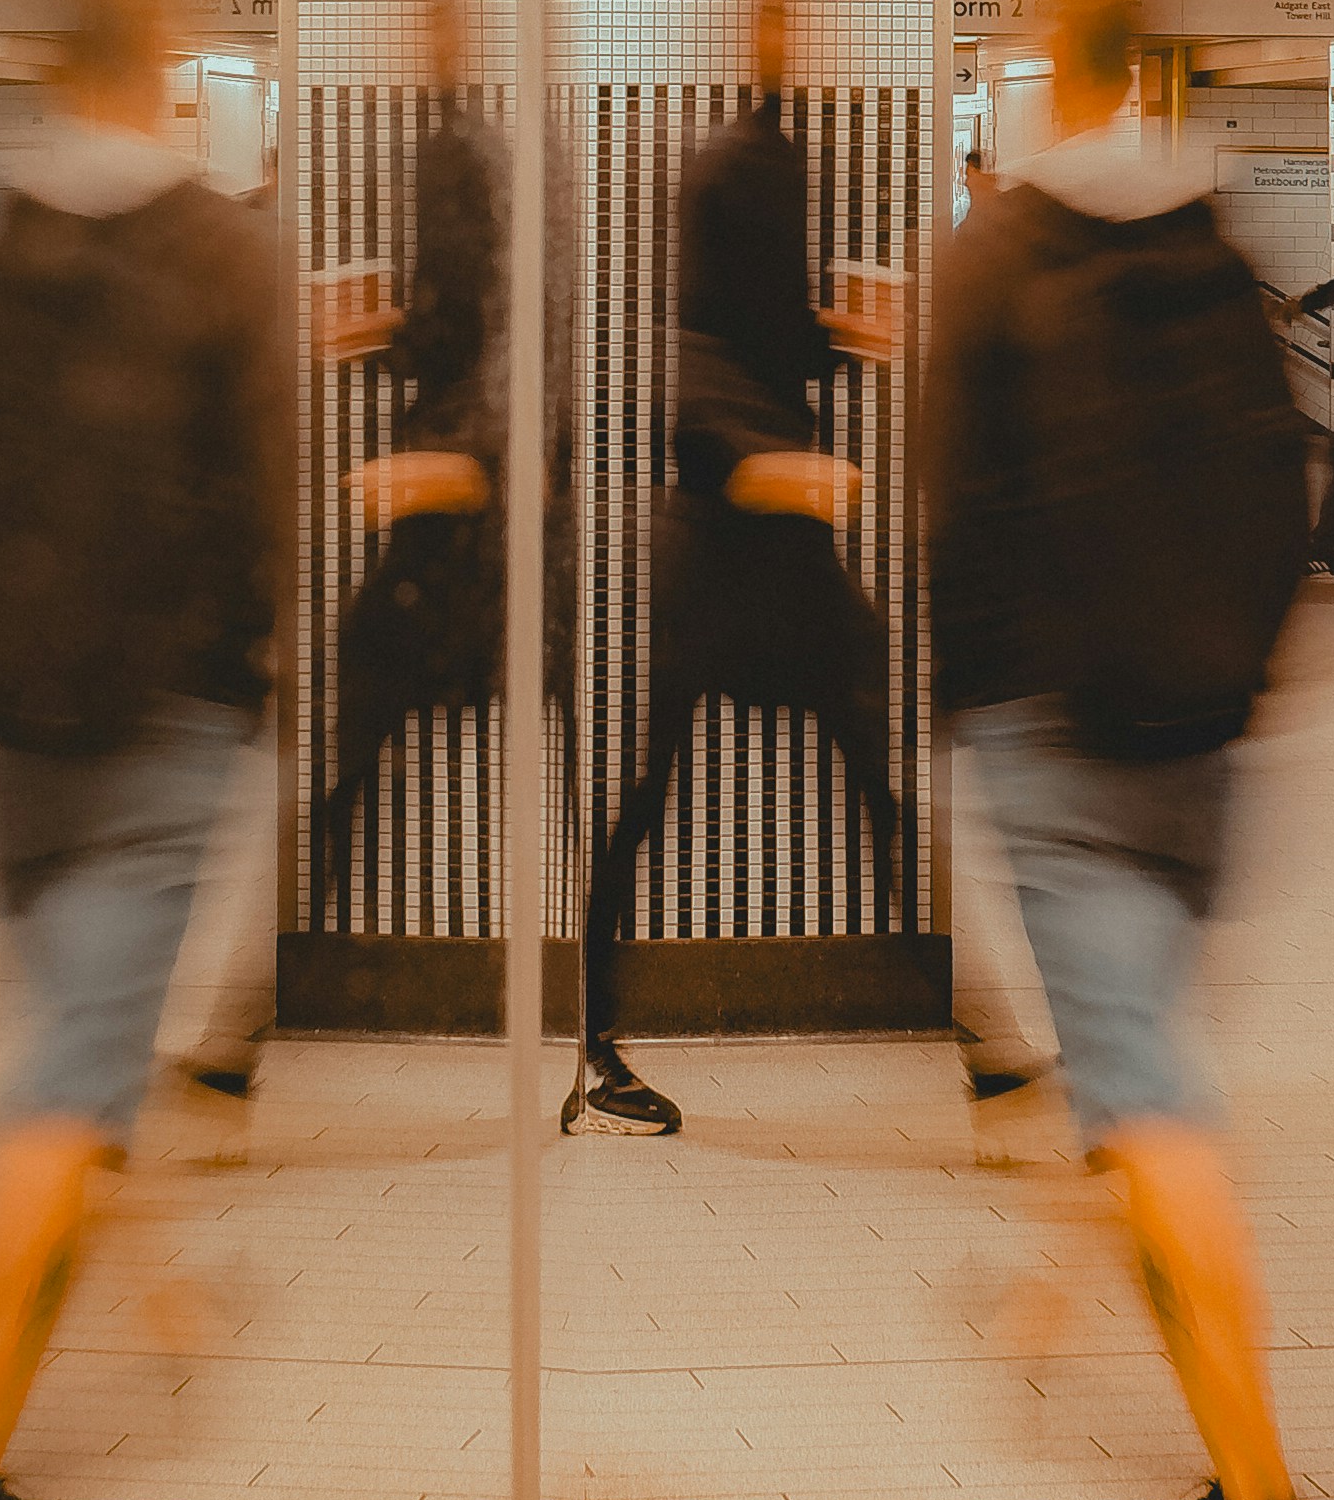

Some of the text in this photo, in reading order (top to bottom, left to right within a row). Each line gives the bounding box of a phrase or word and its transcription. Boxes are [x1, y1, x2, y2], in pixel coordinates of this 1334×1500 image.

[1275, 1, 1331, 11] Aldgate East
[1286, 12, 1331, 20] Tower Hill
[1254, 177, 1308, 187] Eastbound
